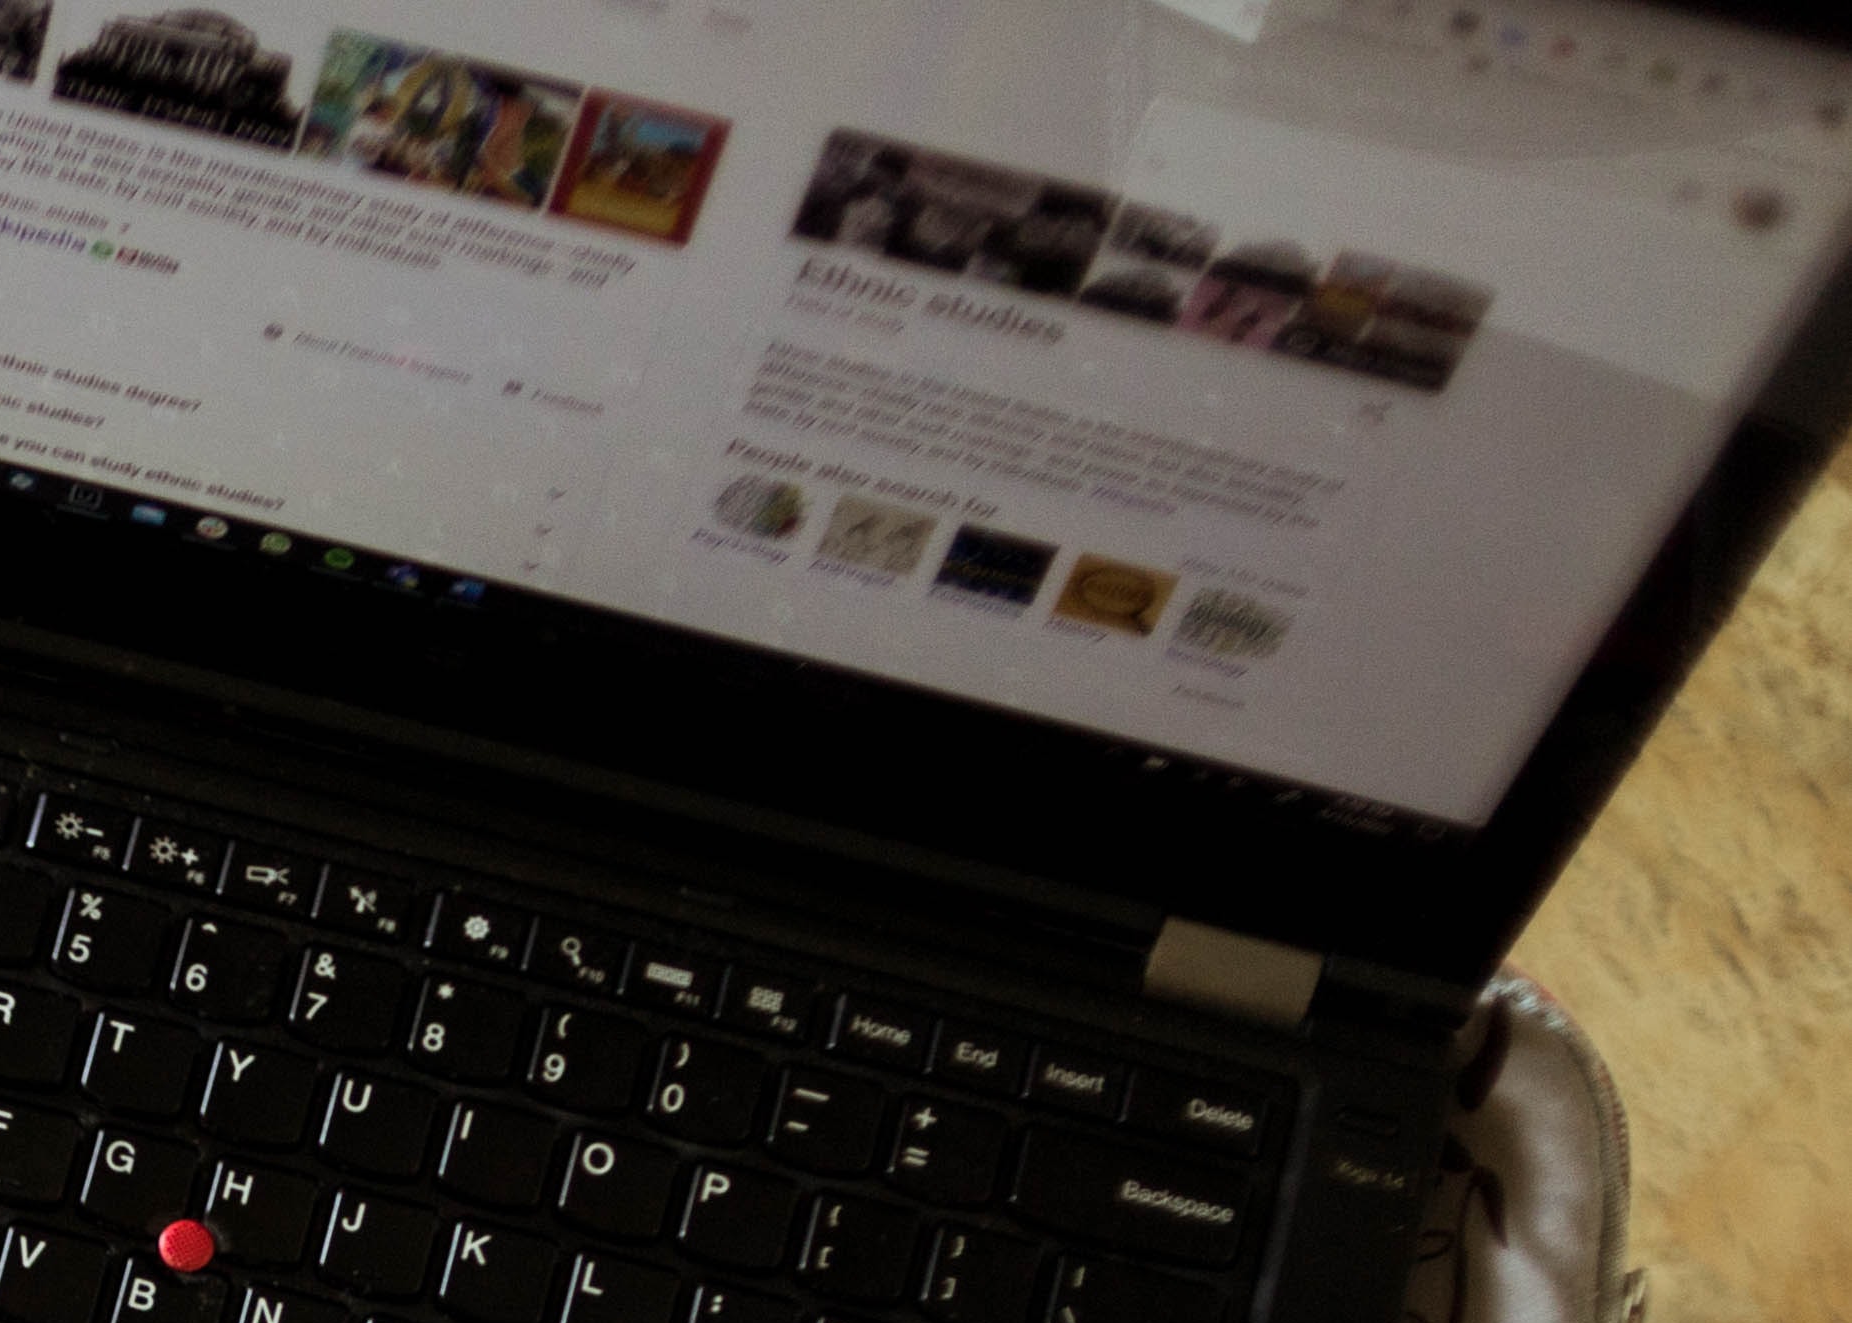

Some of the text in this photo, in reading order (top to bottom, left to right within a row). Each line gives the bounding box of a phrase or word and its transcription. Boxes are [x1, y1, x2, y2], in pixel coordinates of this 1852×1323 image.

[109, 1021, 136, 1052] T
[851, 1014, 911, 1045] Home
[228, 1051, 256, 1082] Y
[953, 1041, 998, 1068] End
[1045, 1062, 1105, 1093] Insert
[1187, 1097, 1255, 1132] Delete
[1120, 1179, 1235, 1225] Backspace
